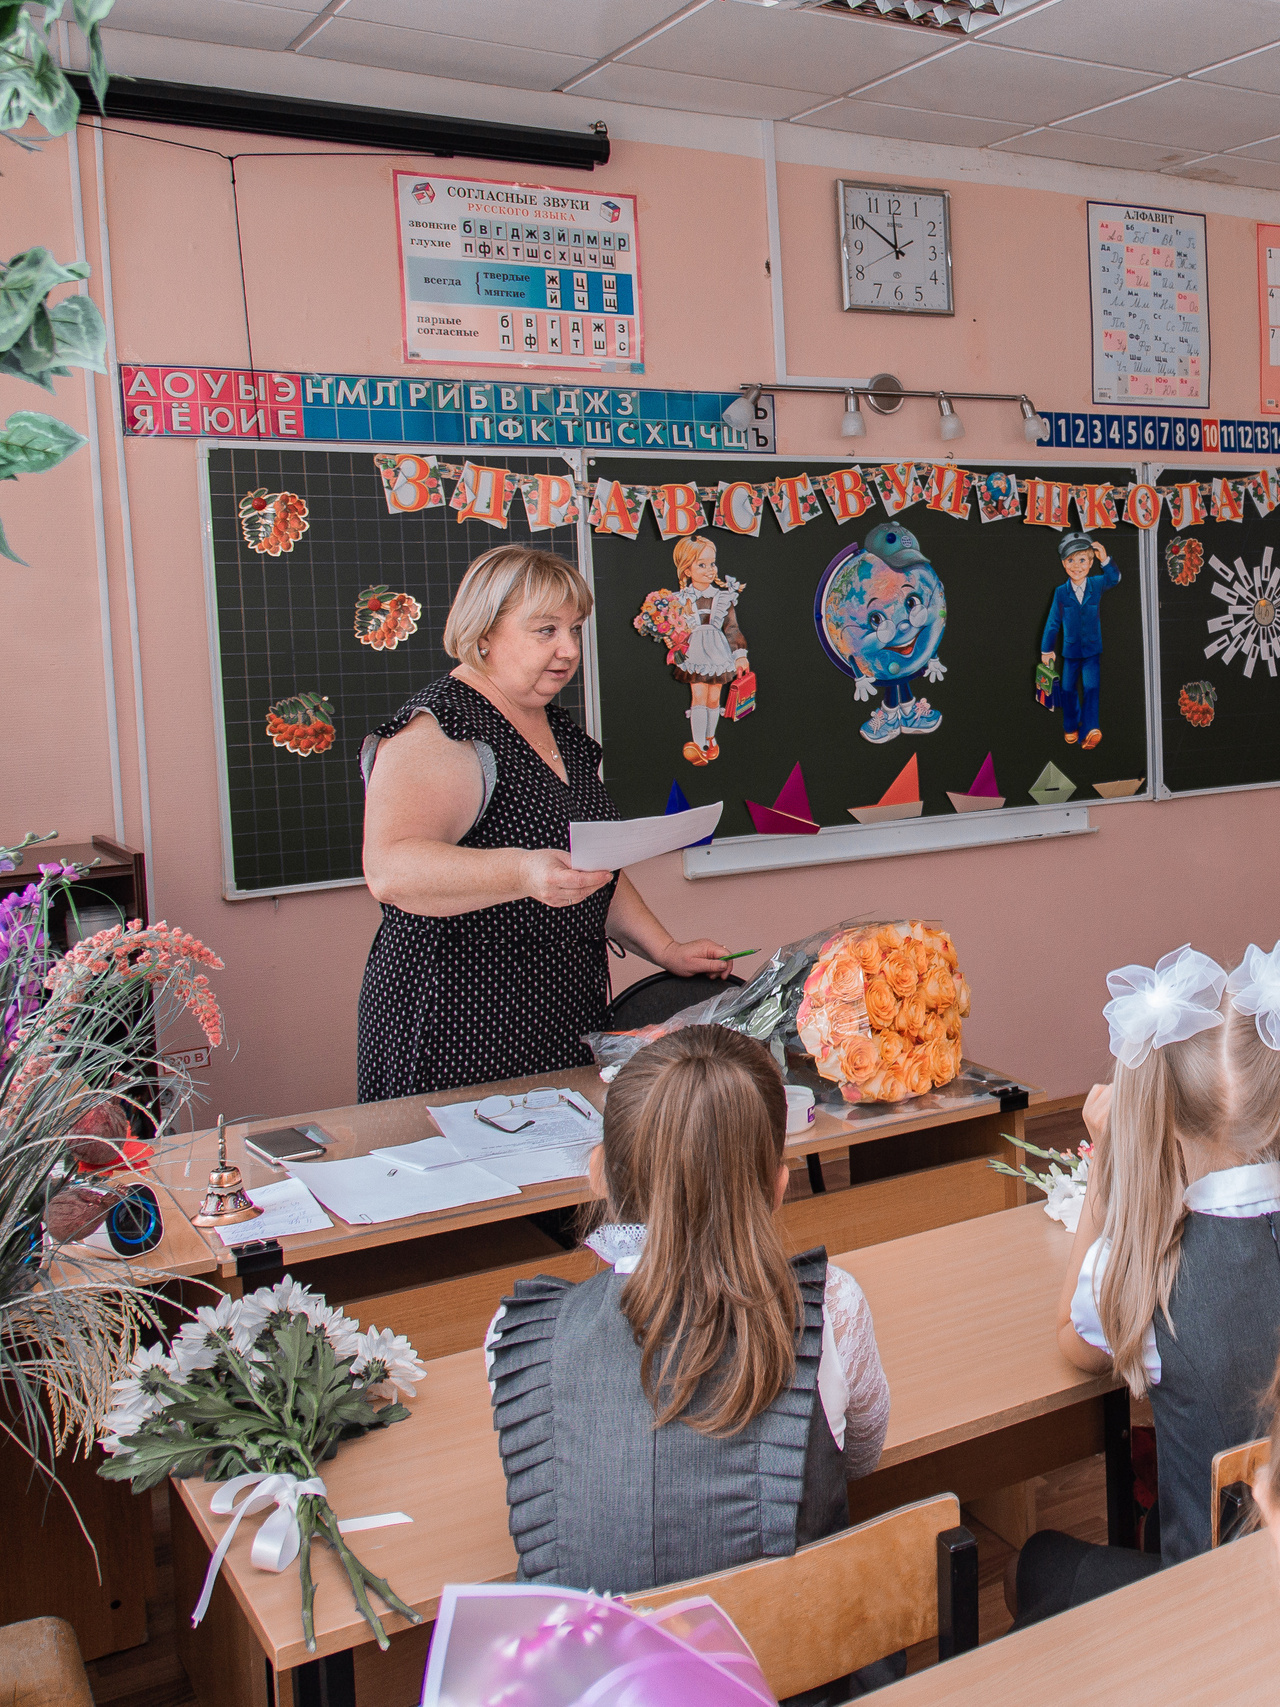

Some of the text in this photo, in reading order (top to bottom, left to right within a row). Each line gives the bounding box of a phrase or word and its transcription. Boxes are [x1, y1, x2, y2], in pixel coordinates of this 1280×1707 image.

[447, 186, 590, 211] СОГЛАСНЫЕ ЗВУКИ
[468, 203, 576, 222] РУССКОГО ЯЗЫКА
[868, 197, 918, 217] 11 12 1
[851, 214, 864, 230] 10
[1124, 211, 1174, 224] АЛФАВИТ
[409, 219, 626, 250] звонкие б в г д ж з й л м н р
[927, 221, 936, 236] 2
[410, 238, 614, 267] глухие п ф к т ш с х ц ч щ
[854, 240, 863, 255] 9
[929, 246, 937, 261] 3
[1268, 249, 1272, 258] 1
[483, 270, 531, 283] твердые
[855, 265, 864, 280] 8
[930, 270, 938, 285] 4
[424, 276, 462, 286] всегда
[484, 288, 525, 299] мягкие
[873, 283, 882, 298] 7
[894, 285, 903, 300] 6
[915, 287, 923, 301] 5
[1269, 289, 1274, 298] 4
[417, 314, 625, 333] парные б в г д ж з
[417, 327, 626, 351] согласные п ф к т ш с
[1271, 330, 1275, 338] 7
[128, 371, 157, 397] А
[164, 372, 195, 397] О
[203, 374, 227, 399] У
[238, 375, 265, 401] Ы
[274, 377, 296, 403] Э
[306, 380, 330, 403] Н
[337, 381, 367, 406] М
[373, 382, 395, 406] Л
[410, 384, 427, 407] Р
[440, 385, 460, 409] Й
[470, 387, 487, 409] Б
[501, 388, 518, 411] В
[532, 390, 546, 411] Г
[556, 390, 579, 415] Д
[584, 392, 610, 414] Ж
[617, 393, 633, 415] З
[134, 403, 769, 449] Я Ё Ю И Е П Ф К Т Ш С Х Ц Ч Щ Ъ
[1058, 418, 1067, 442] 1
[1075, 419, 1086, 442] 2
[1092, 421, 1102, 442] 3
[1109, 421, 1120, 444] 4
[1128, 422, 1137, 445] 5
[1145, 422, 1154, 445] 6
[1161, 422, 1169, 445] 7
[1175, 422, 1185, 446] 8
[1190, 423, 1199, 446] 9
[1204, 424, 1217, 448] 10
[1221, 424, 1236, 448] 11
[1238, 426, 1252, 448] 12
[1255, 426, 1269, 449] 13
[389, 453, 1276, 536] ЗДРАВСТВУЙ ШКОЛА!
